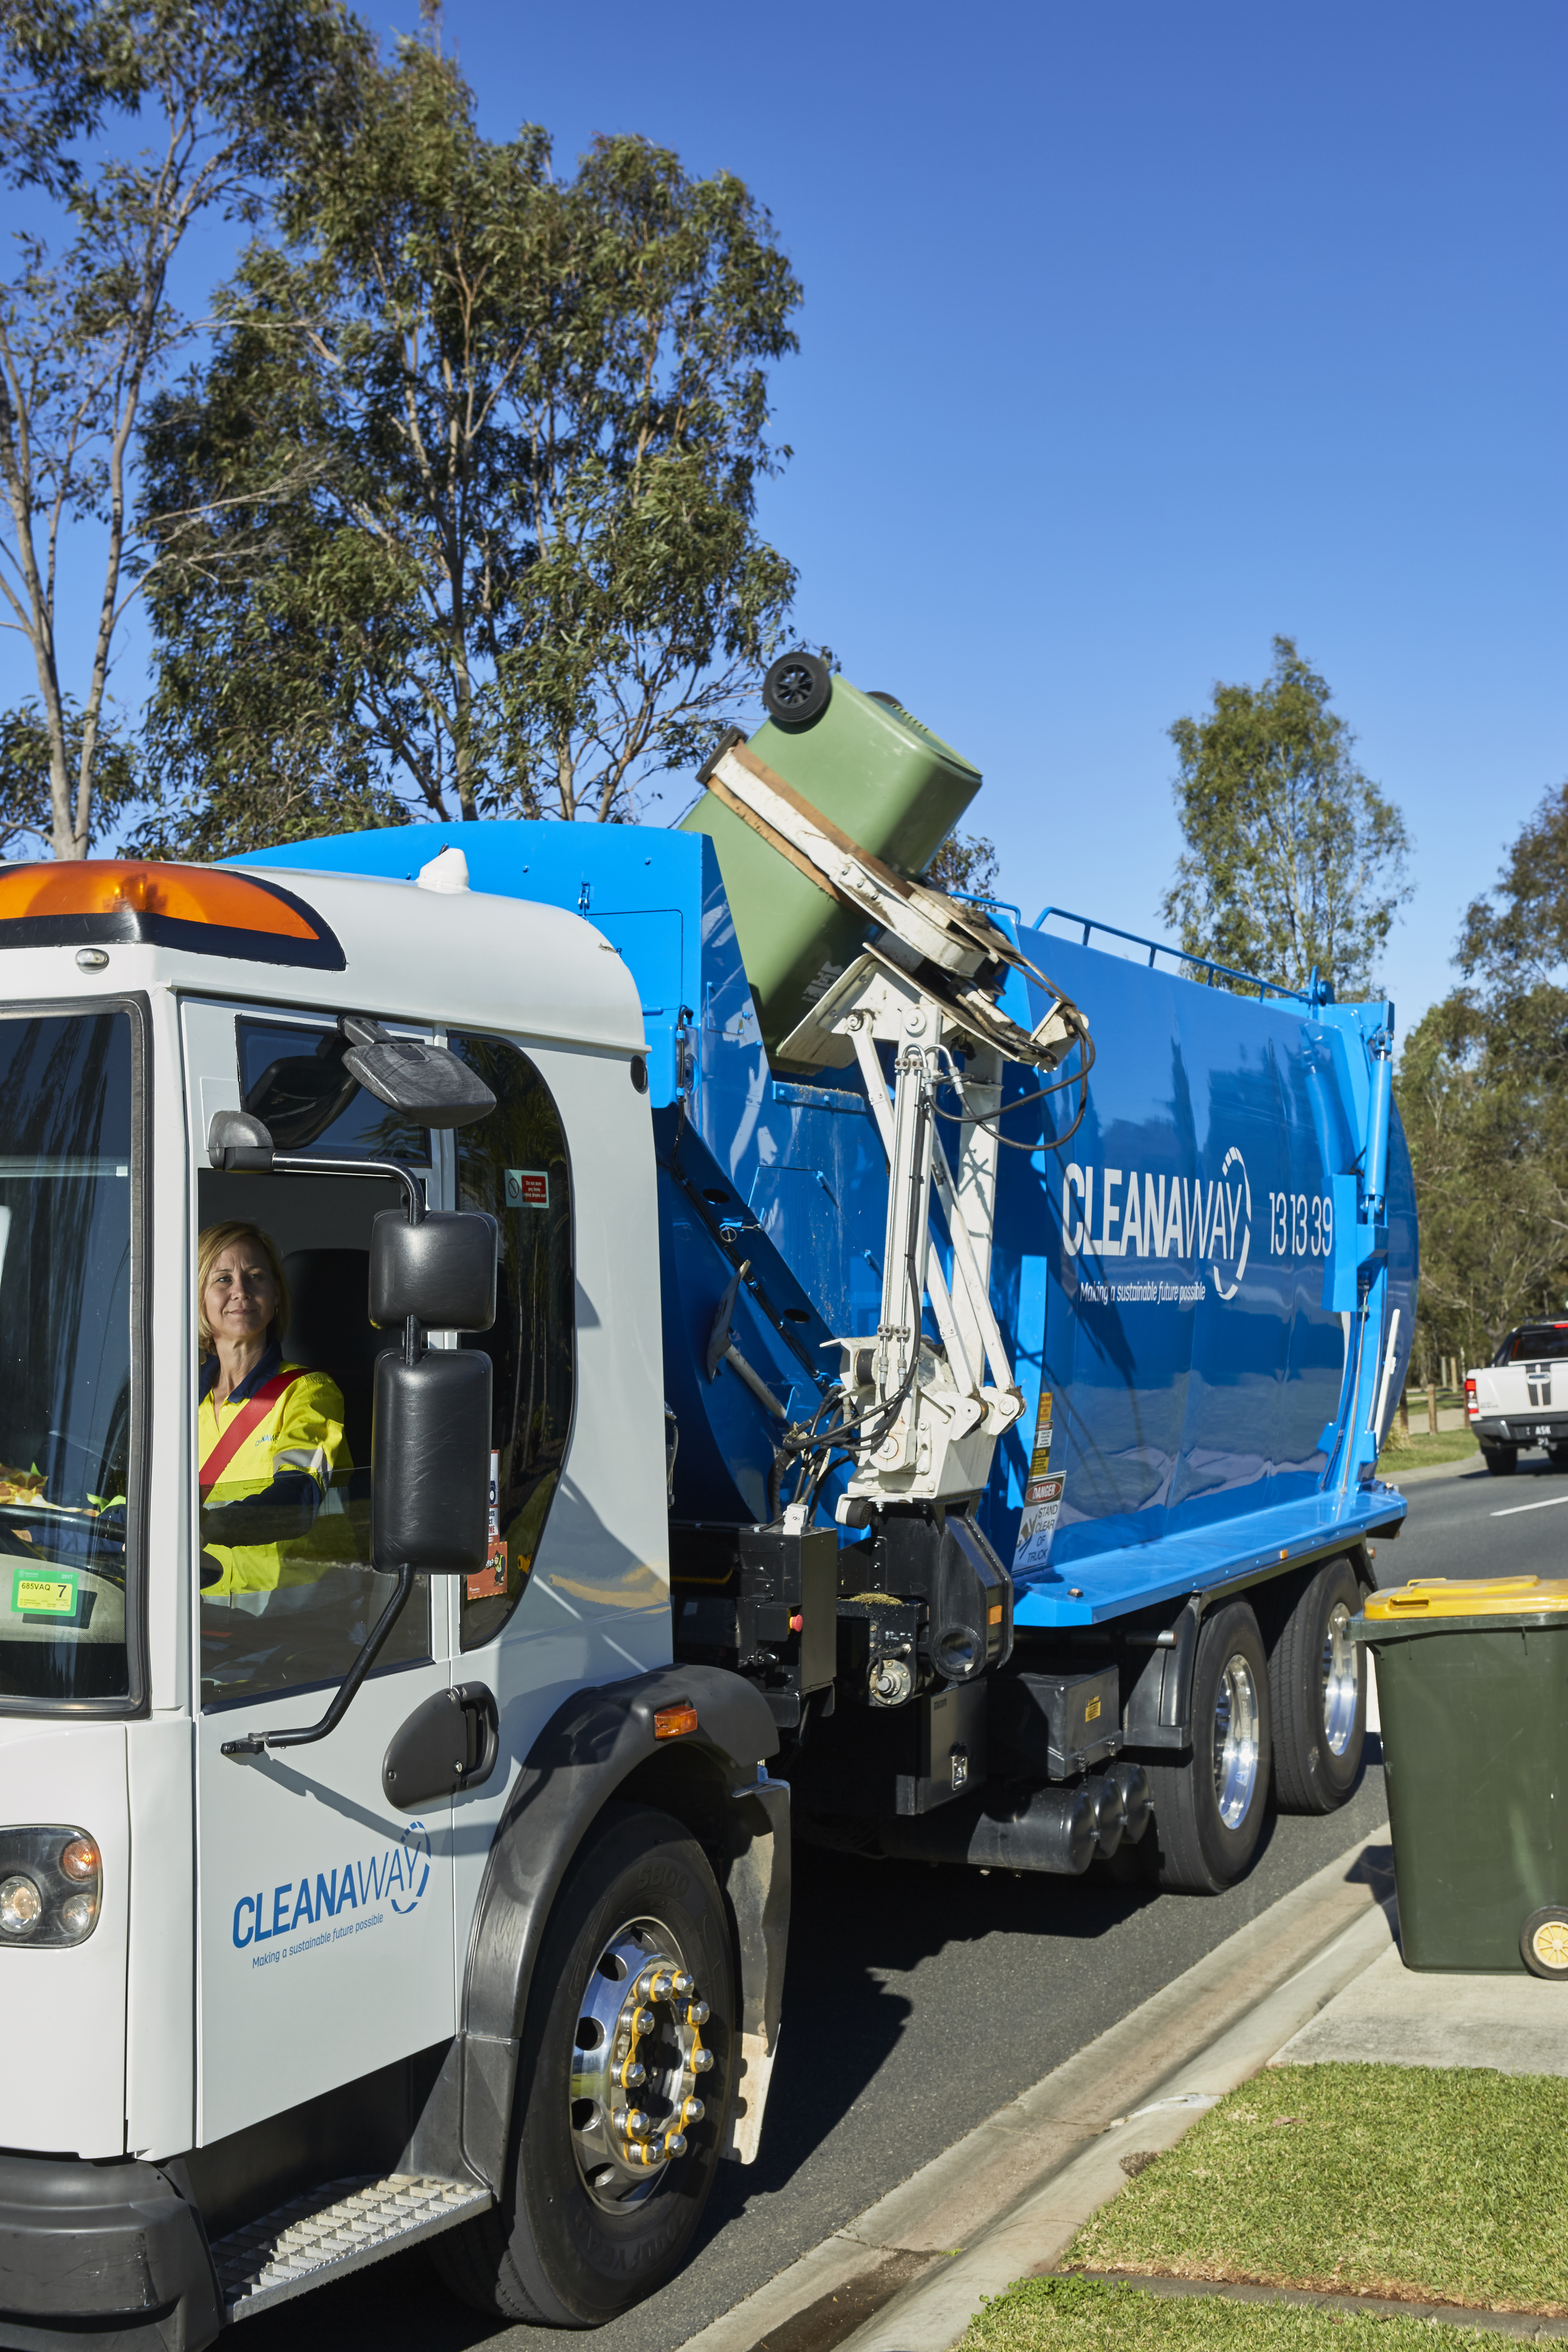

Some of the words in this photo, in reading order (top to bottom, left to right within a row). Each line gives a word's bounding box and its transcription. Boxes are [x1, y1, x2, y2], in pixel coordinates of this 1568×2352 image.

[1062, 1163, 1242, 1260] CLEANAWAY
[1080, 1281, 1109, 1306] Making
[1110, 1286, 1115, 1302] a
[1117, 1281, 1158, 1302] sustainable
[1157, 1281, 1178, 1305] future
[1179, 1281, 1206, 1304] possible
[1032, 1484, 1056, 1500] DANGER
[1038, 1504, 1058, 1518] STAND
[1035, 1519, 1055, 1533] CLEAR
[1037, 1535, 1046, 1547] OF
[1027, 1548, 1048, 1563] TRUCK
[22, 1582, 51, 1591] 685VAQ
[58, 1585, 67, 1598] 7
[232, 1841, 421, 1949] CLEANAWAY
[252, 1951, 280, 1969] Making
[282, 1948, 287, 1958] a
[289, 1932, 331, 1955] sustainable
[332, 1925, 354, 1942] future
[355, 1913, 383, 1933] possible
